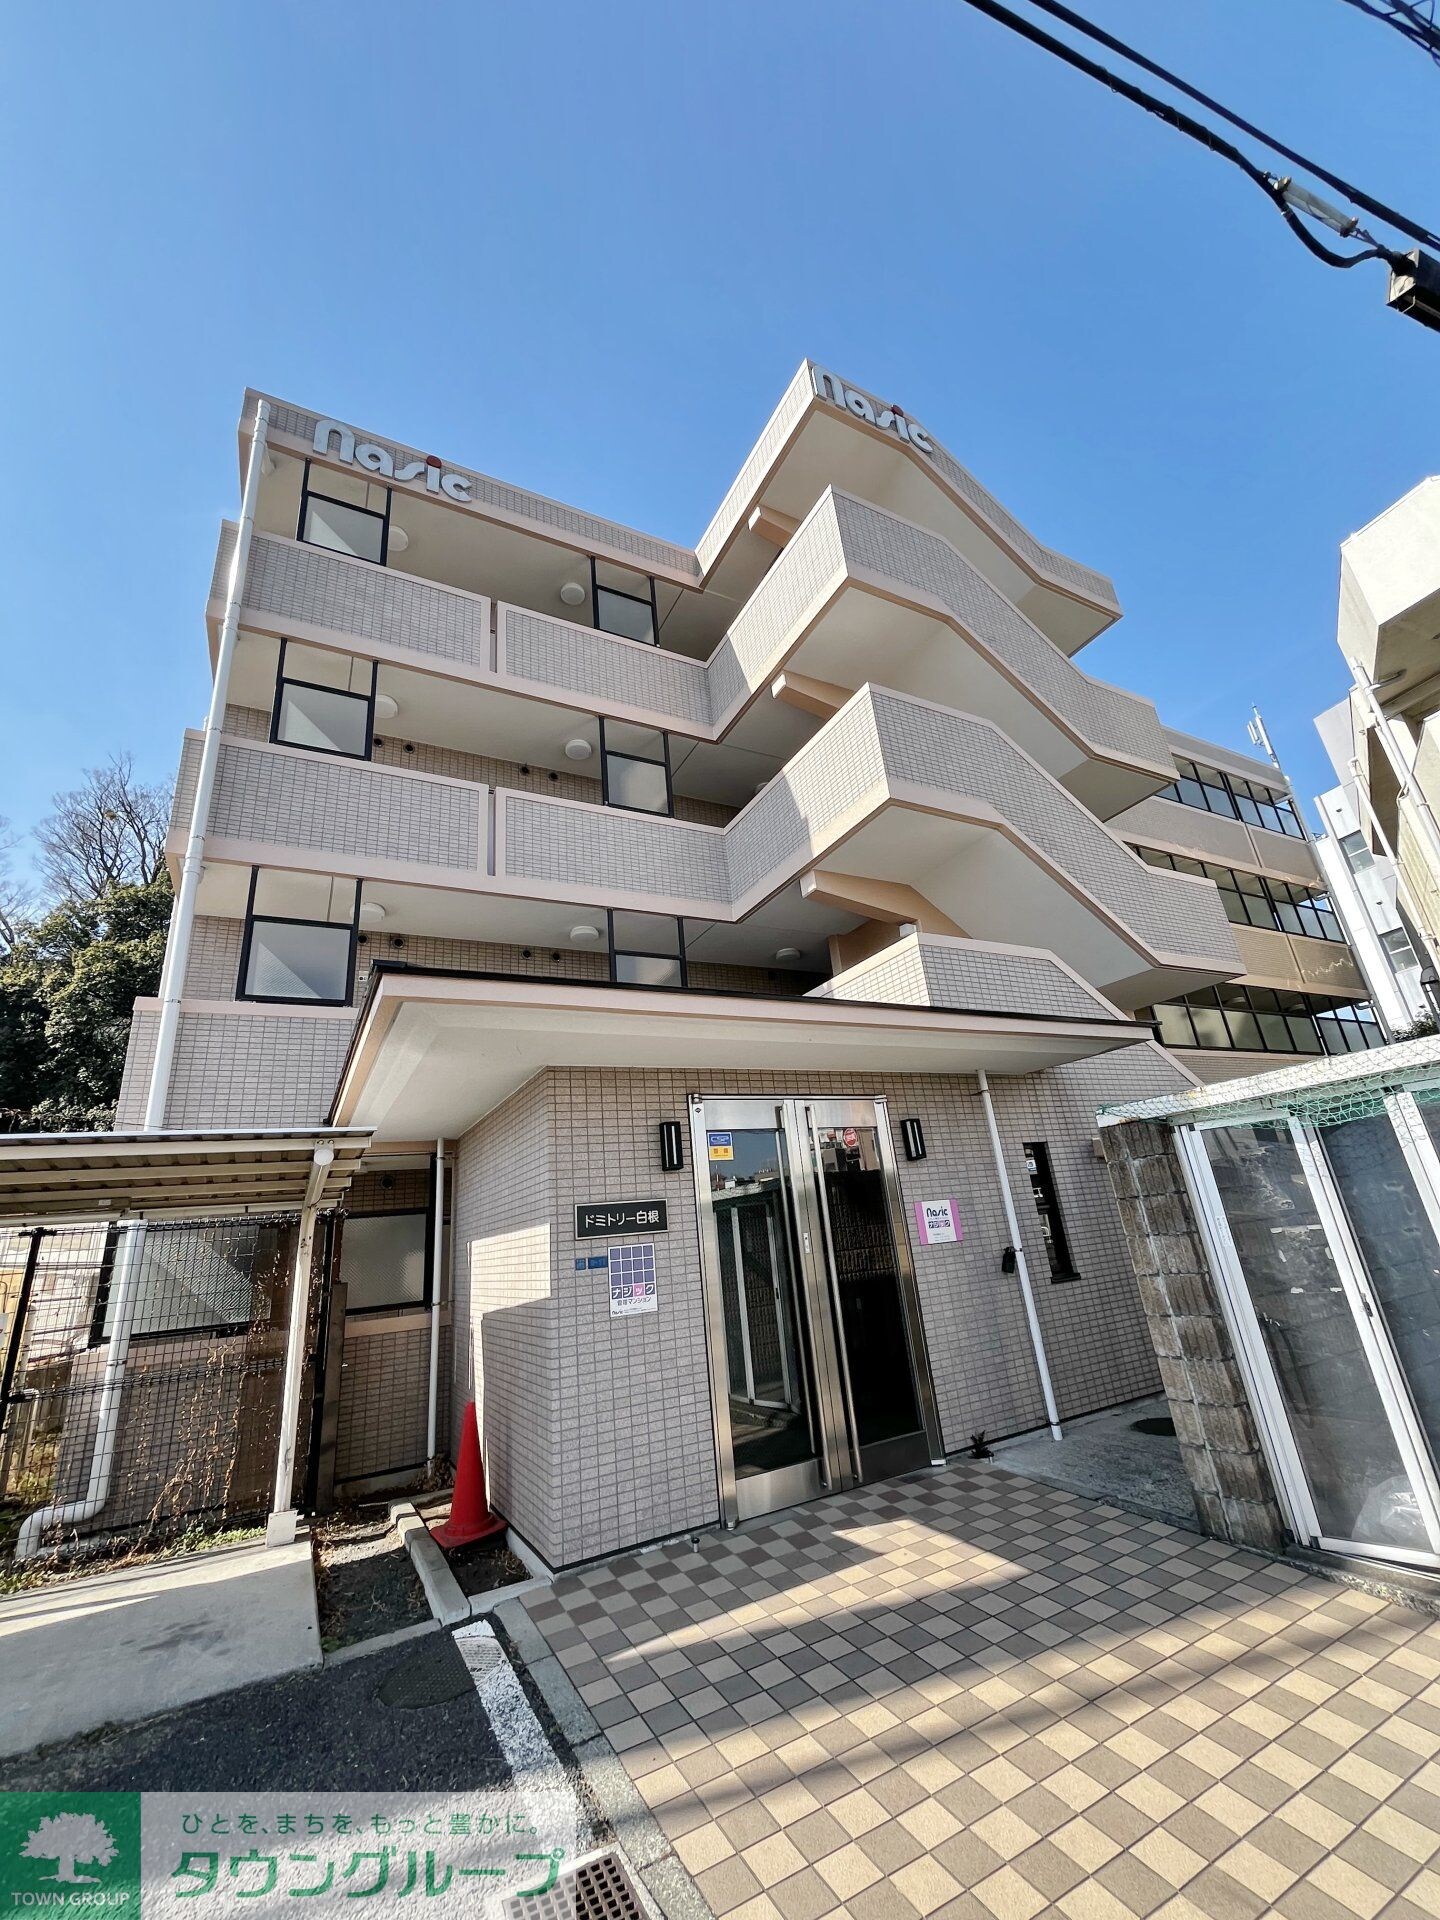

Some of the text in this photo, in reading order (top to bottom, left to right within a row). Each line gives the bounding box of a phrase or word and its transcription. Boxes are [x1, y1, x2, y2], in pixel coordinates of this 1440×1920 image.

[585, 1210, 660, 1228] ドミトリー白根
[612, 1283, 655, 1299] ナジック
